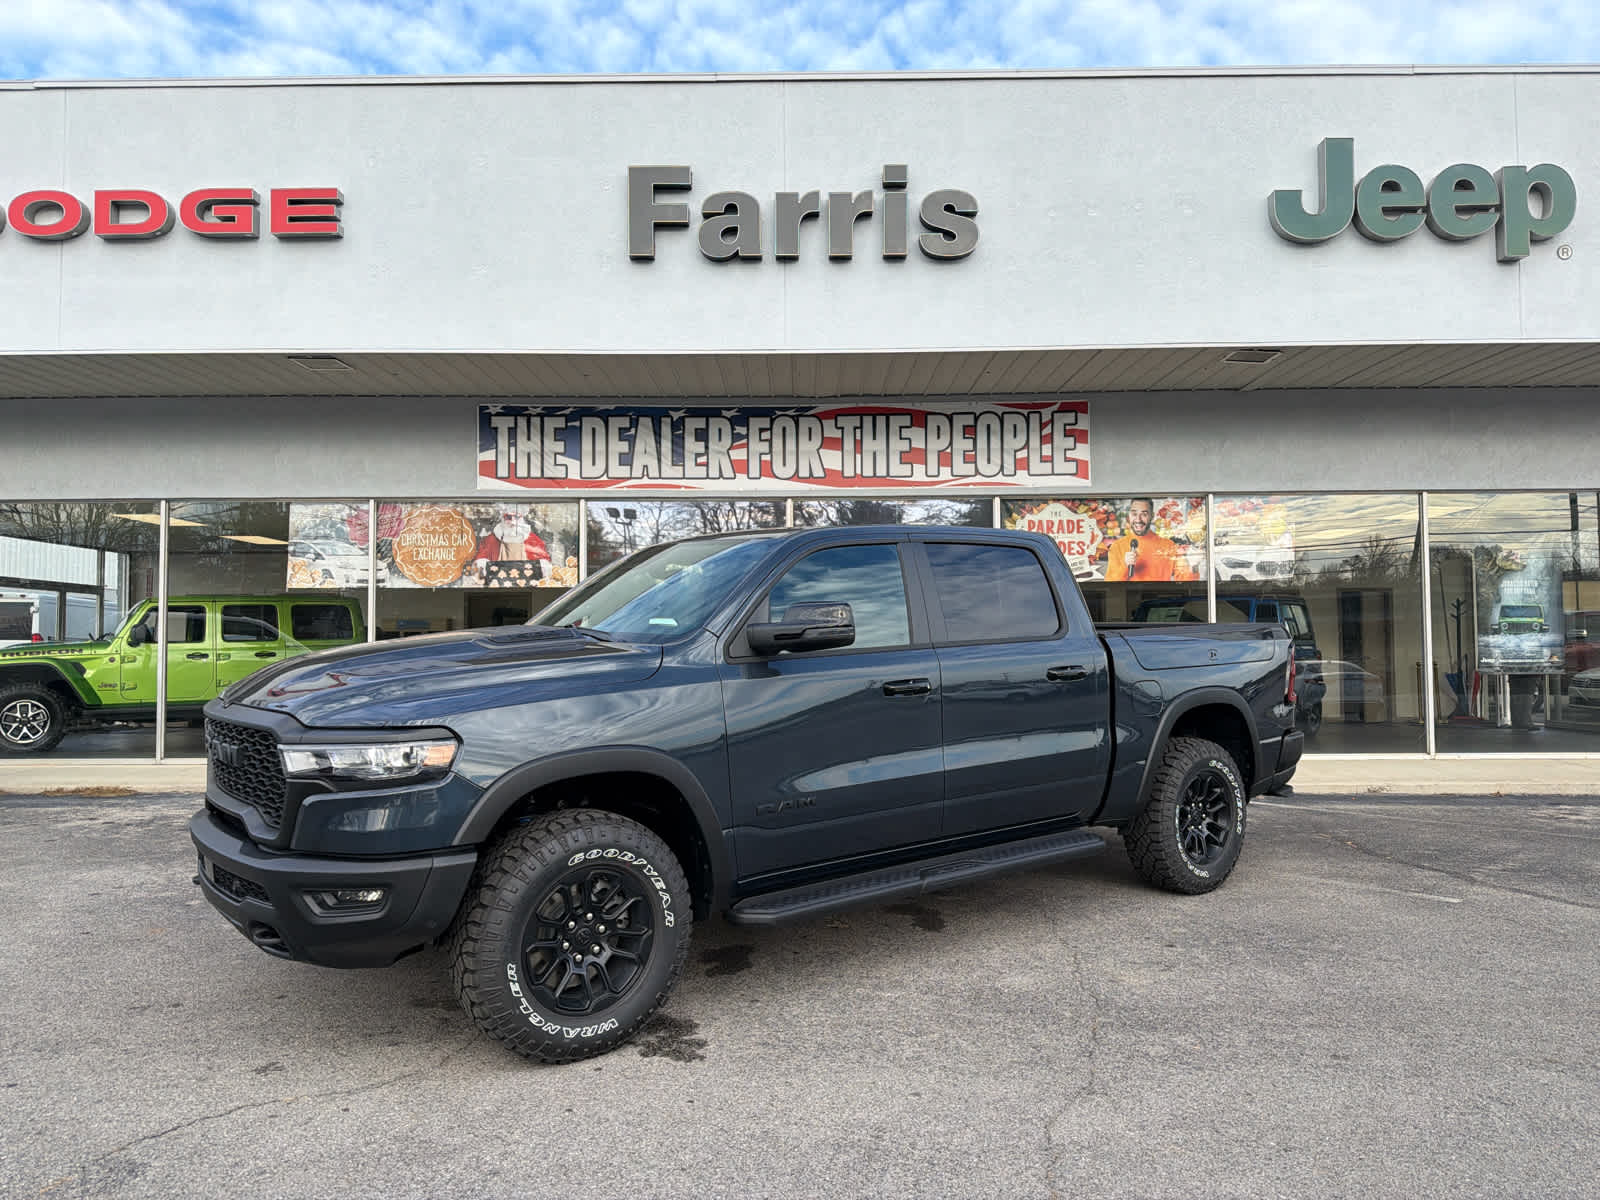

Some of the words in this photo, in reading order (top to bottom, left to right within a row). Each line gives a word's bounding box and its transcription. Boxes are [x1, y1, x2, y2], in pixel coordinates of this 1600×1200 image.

[0, 187, 344, 240] ODGE
[627, 164, 980, 261] Farris
[1268, 137, 1577, 263] Jeep
[490, 415, 568, 479] THE
[579, 415, 736, 480] DEALER
[747, 414, 826, 480] FOR
[834, 412, 913, 478] THE
[925, 410, 1078, 478] PEOPLE
[401, 532, 449, 546] CHRISTMAS
[451, 532, 469, 546] CAR
[413, 547, 457, 560] EXCHANGE
[1027, 519, 1086, 535] PARADE
[1, 648, 84, 657] RUBICON
[568, 848, 675, 928] GOODYEAR
[506, 963, 619, 1039] WRANGLER
